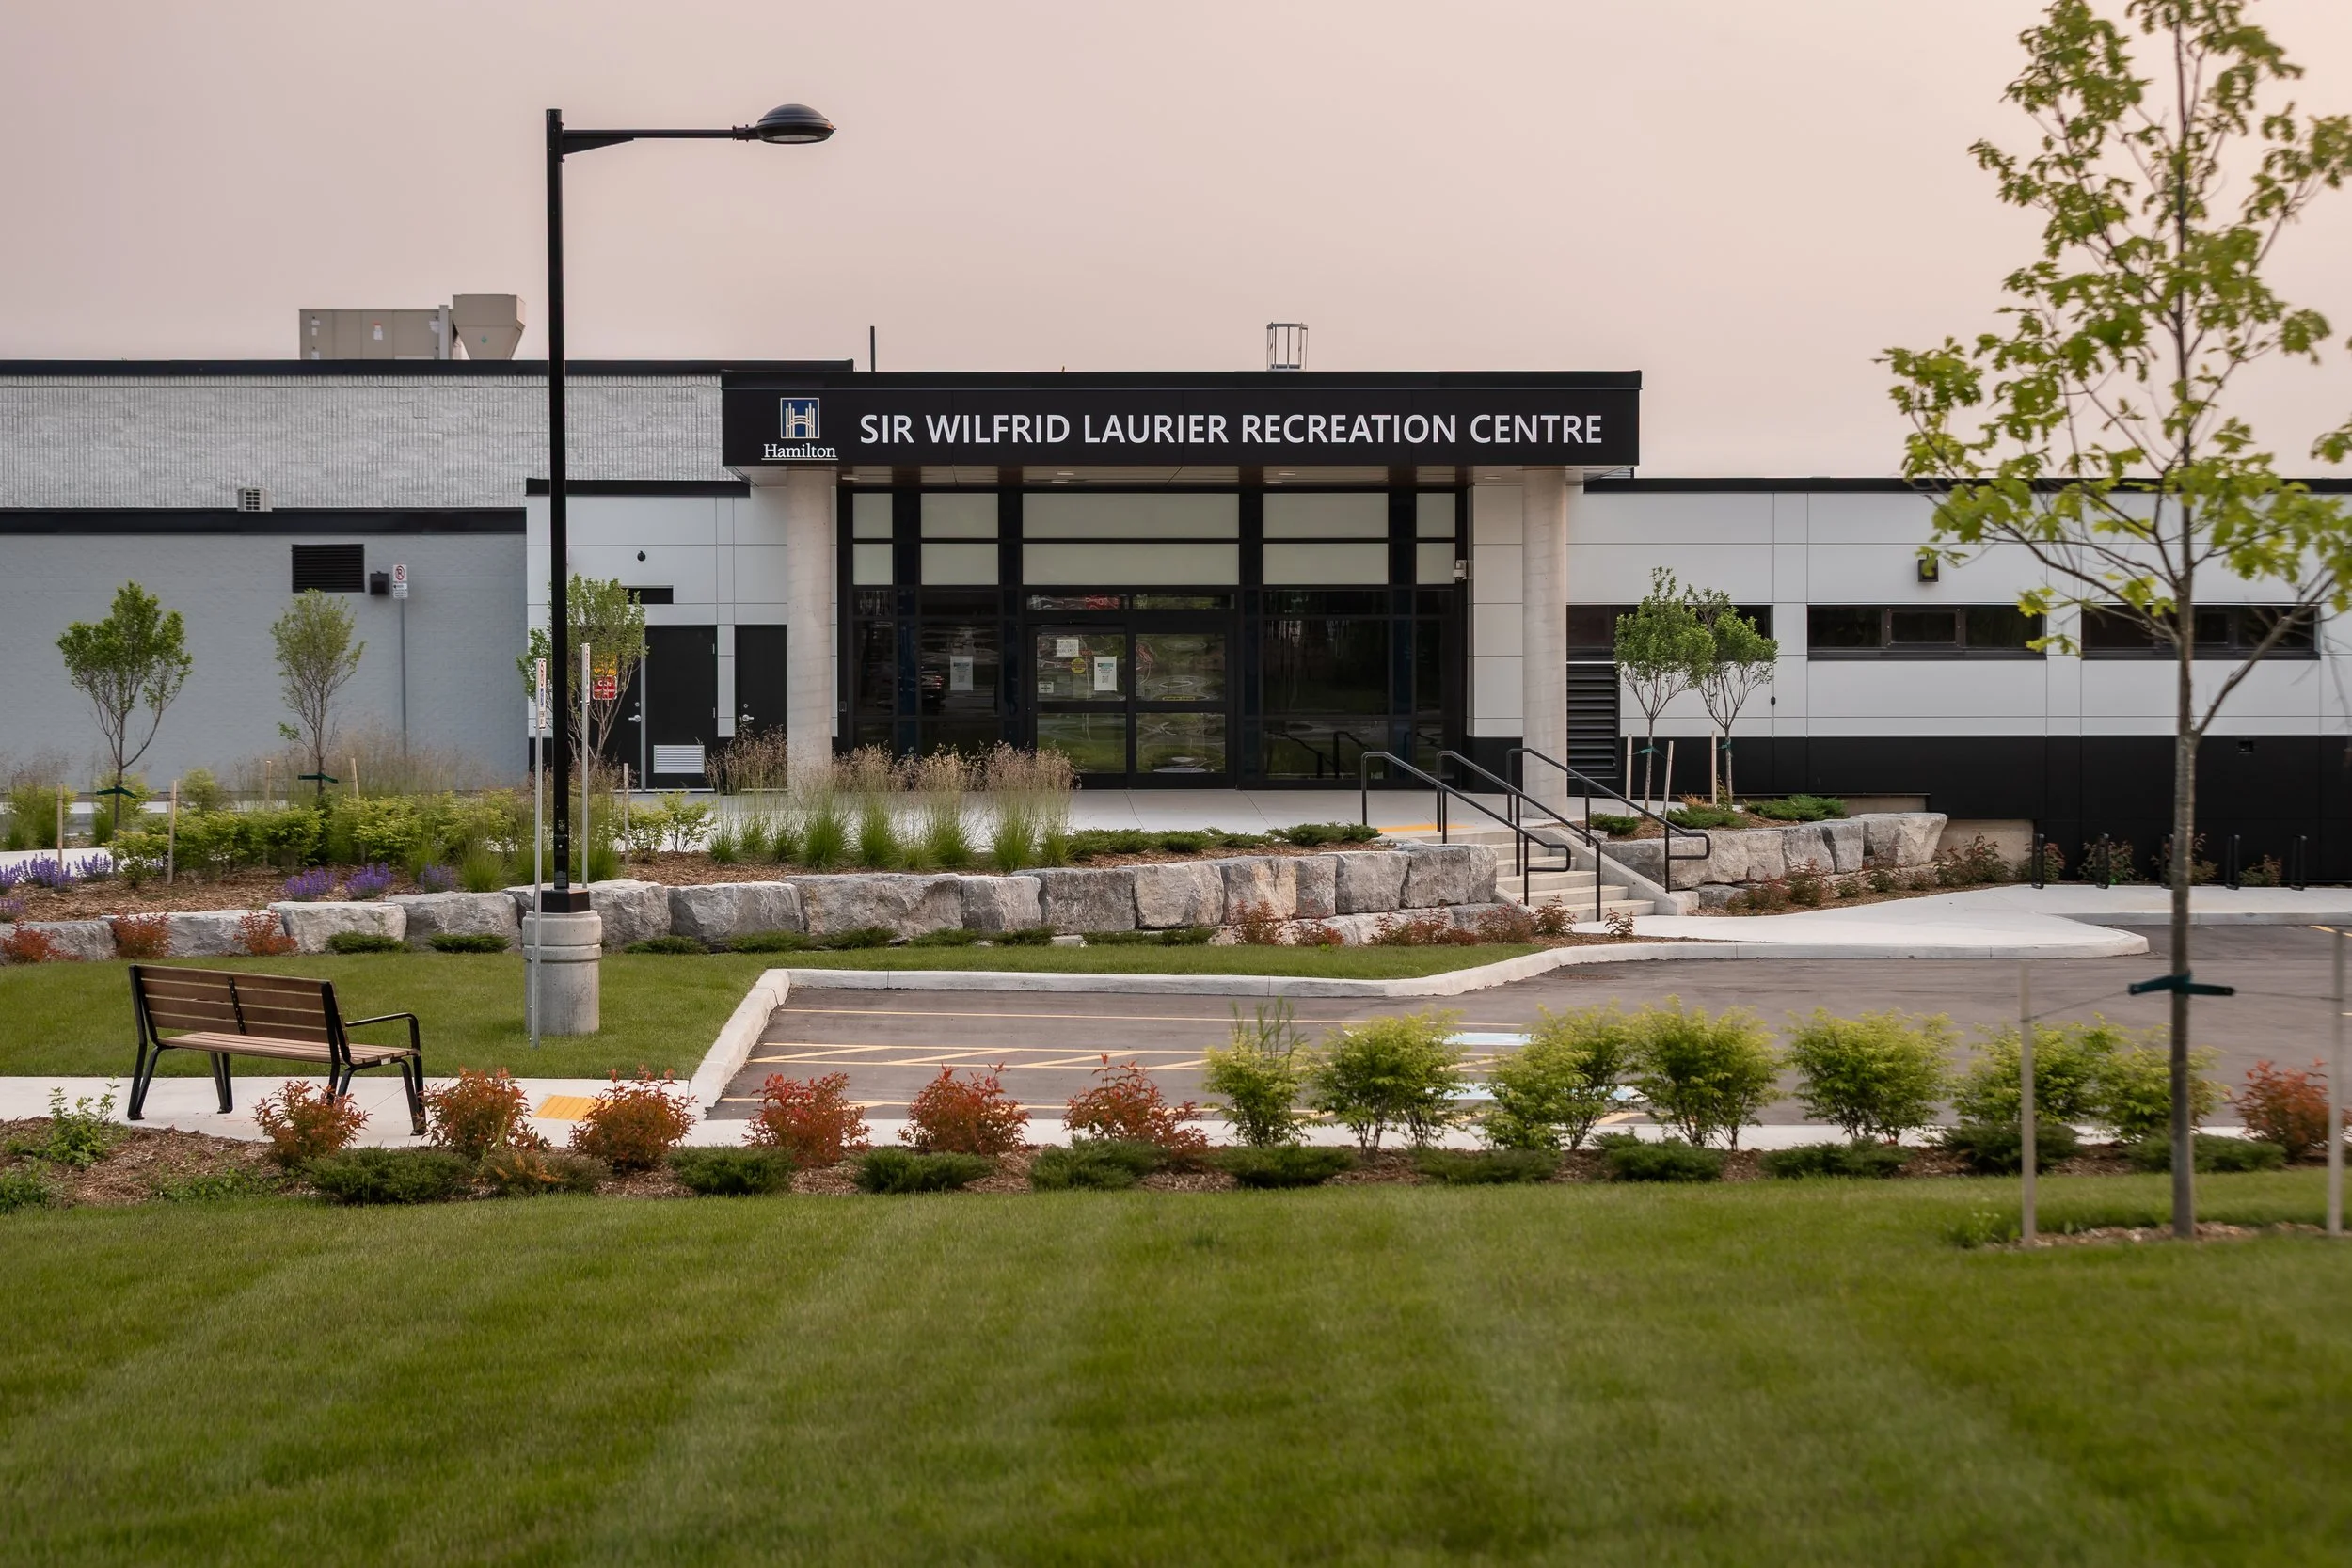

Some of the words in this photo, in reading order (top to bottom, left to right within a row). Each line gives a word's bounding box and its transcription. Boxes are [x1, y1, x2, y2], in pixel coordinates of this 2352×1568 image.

[860, 414, 914, 443] SIR
[924, 414, 1070, 443] WILFRID
[1083, 414, 1230, 443] LAURIER
[1242, 414, 1456, 443] RECREATION
[1470, 414, 1603, 444] CENTRE
[763, 442, 837, 458] Hamilton
